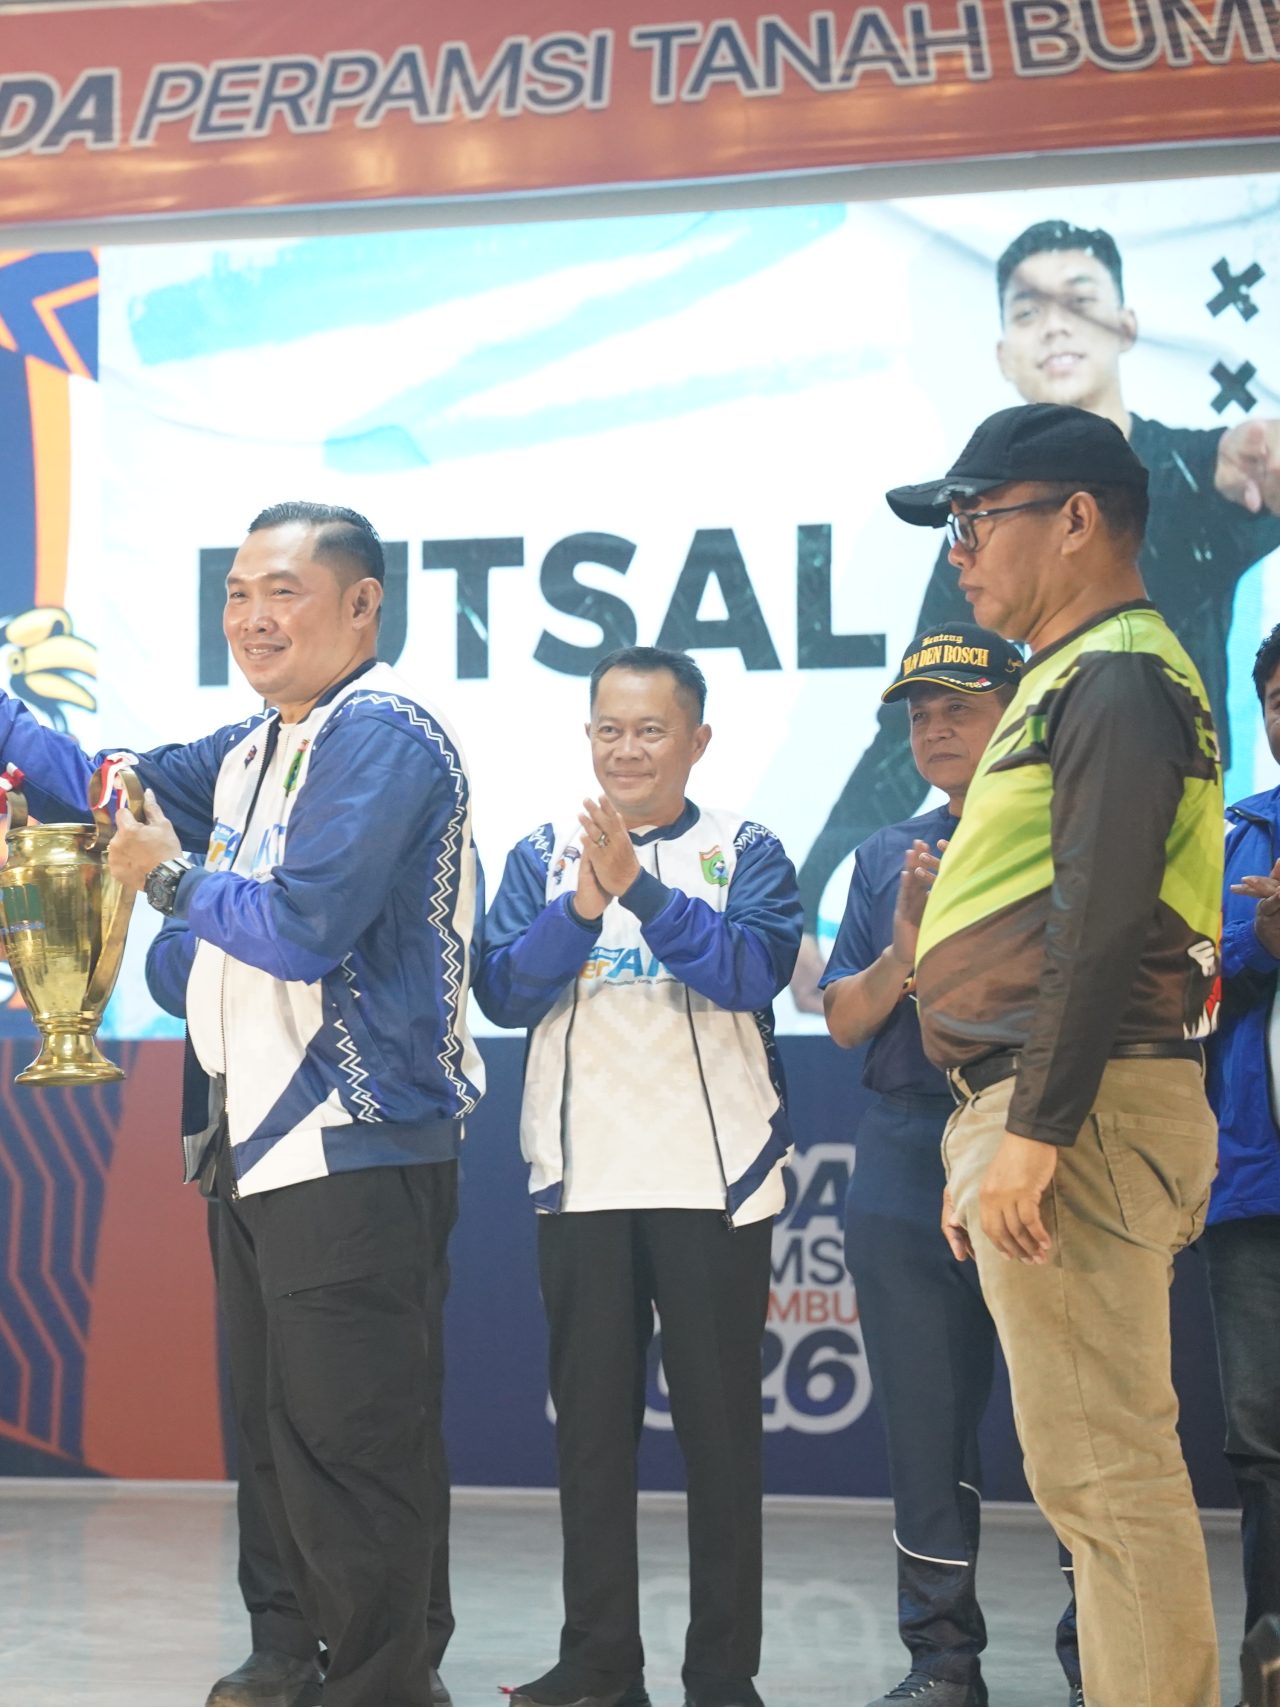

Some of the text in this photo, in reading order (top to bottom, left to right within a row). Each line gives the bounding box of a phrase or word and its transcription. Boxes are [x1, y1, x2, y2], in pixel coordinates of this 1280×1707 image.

[132, 27, 614, 147] PERPAMSI
[632, 4, 993, 103] TANAH
[919, 646, 942, 668] DEN
[943, 645, 989, 667] BOSCH
